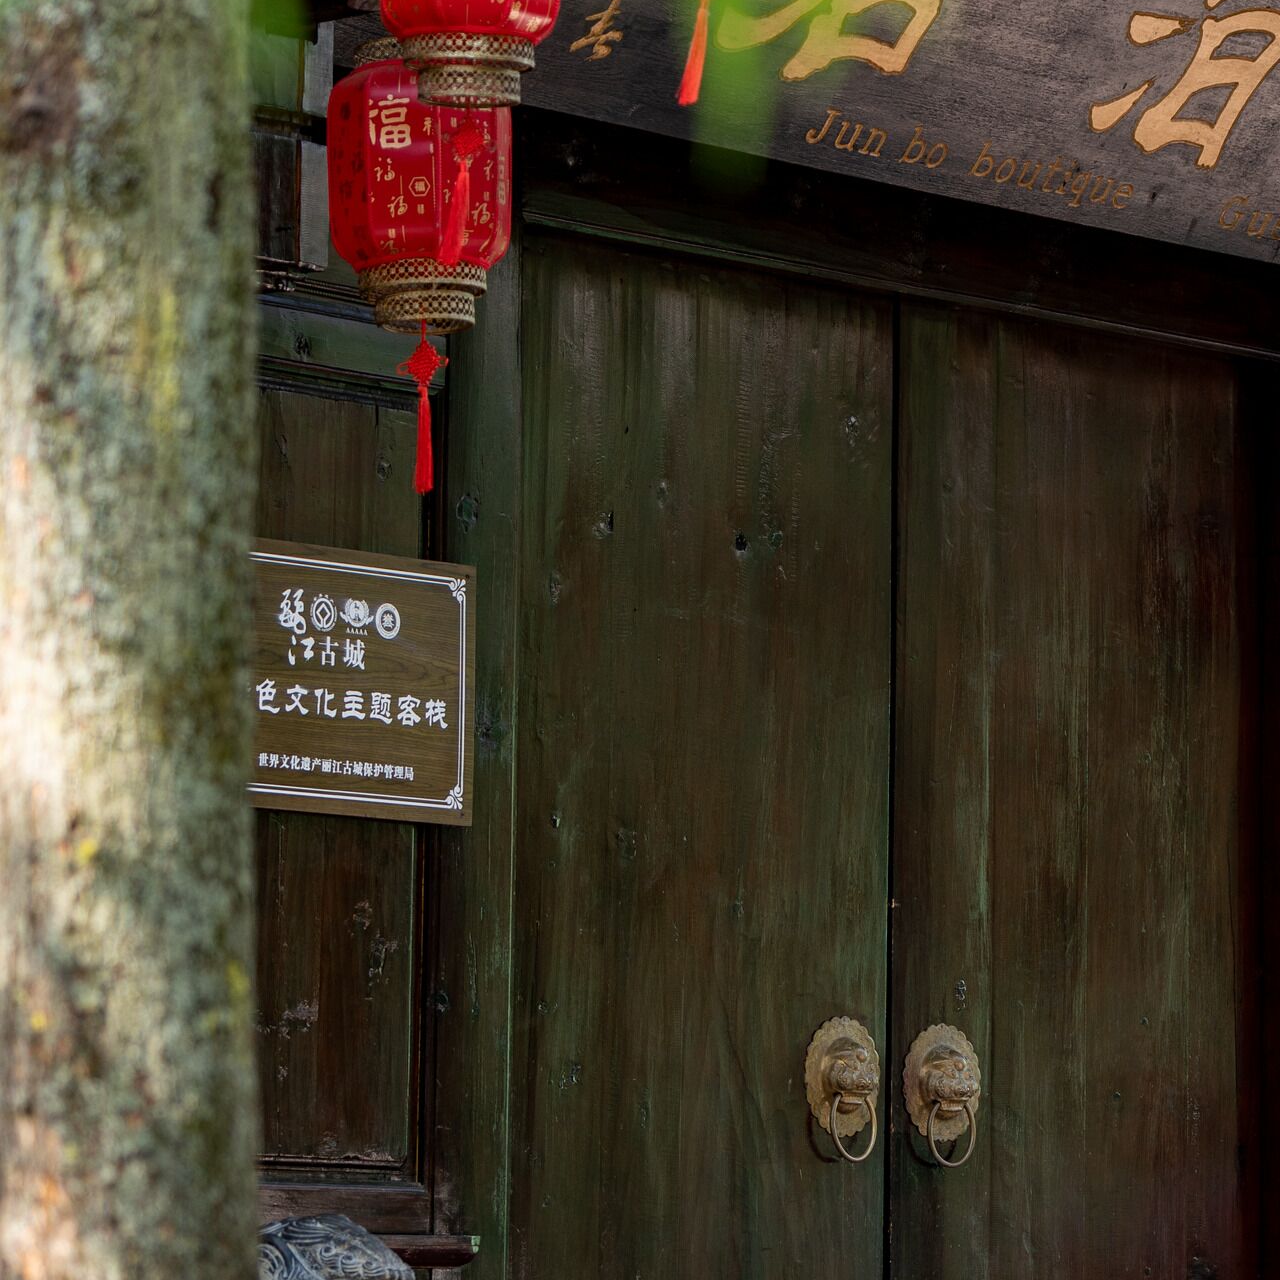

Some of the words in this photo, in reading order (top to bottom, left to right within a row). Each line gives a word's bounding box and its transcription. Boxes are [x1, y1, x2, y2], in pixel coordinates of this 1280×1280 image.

[368, 94, 412, 150] 福
[805, 107, 888, 157] Jun
[898, 122, 950, 171] bo
[968, 141, 1136, 211] boutique
[257, 751, 415, 782] 世界文化遗产丽江古城保护管理局
